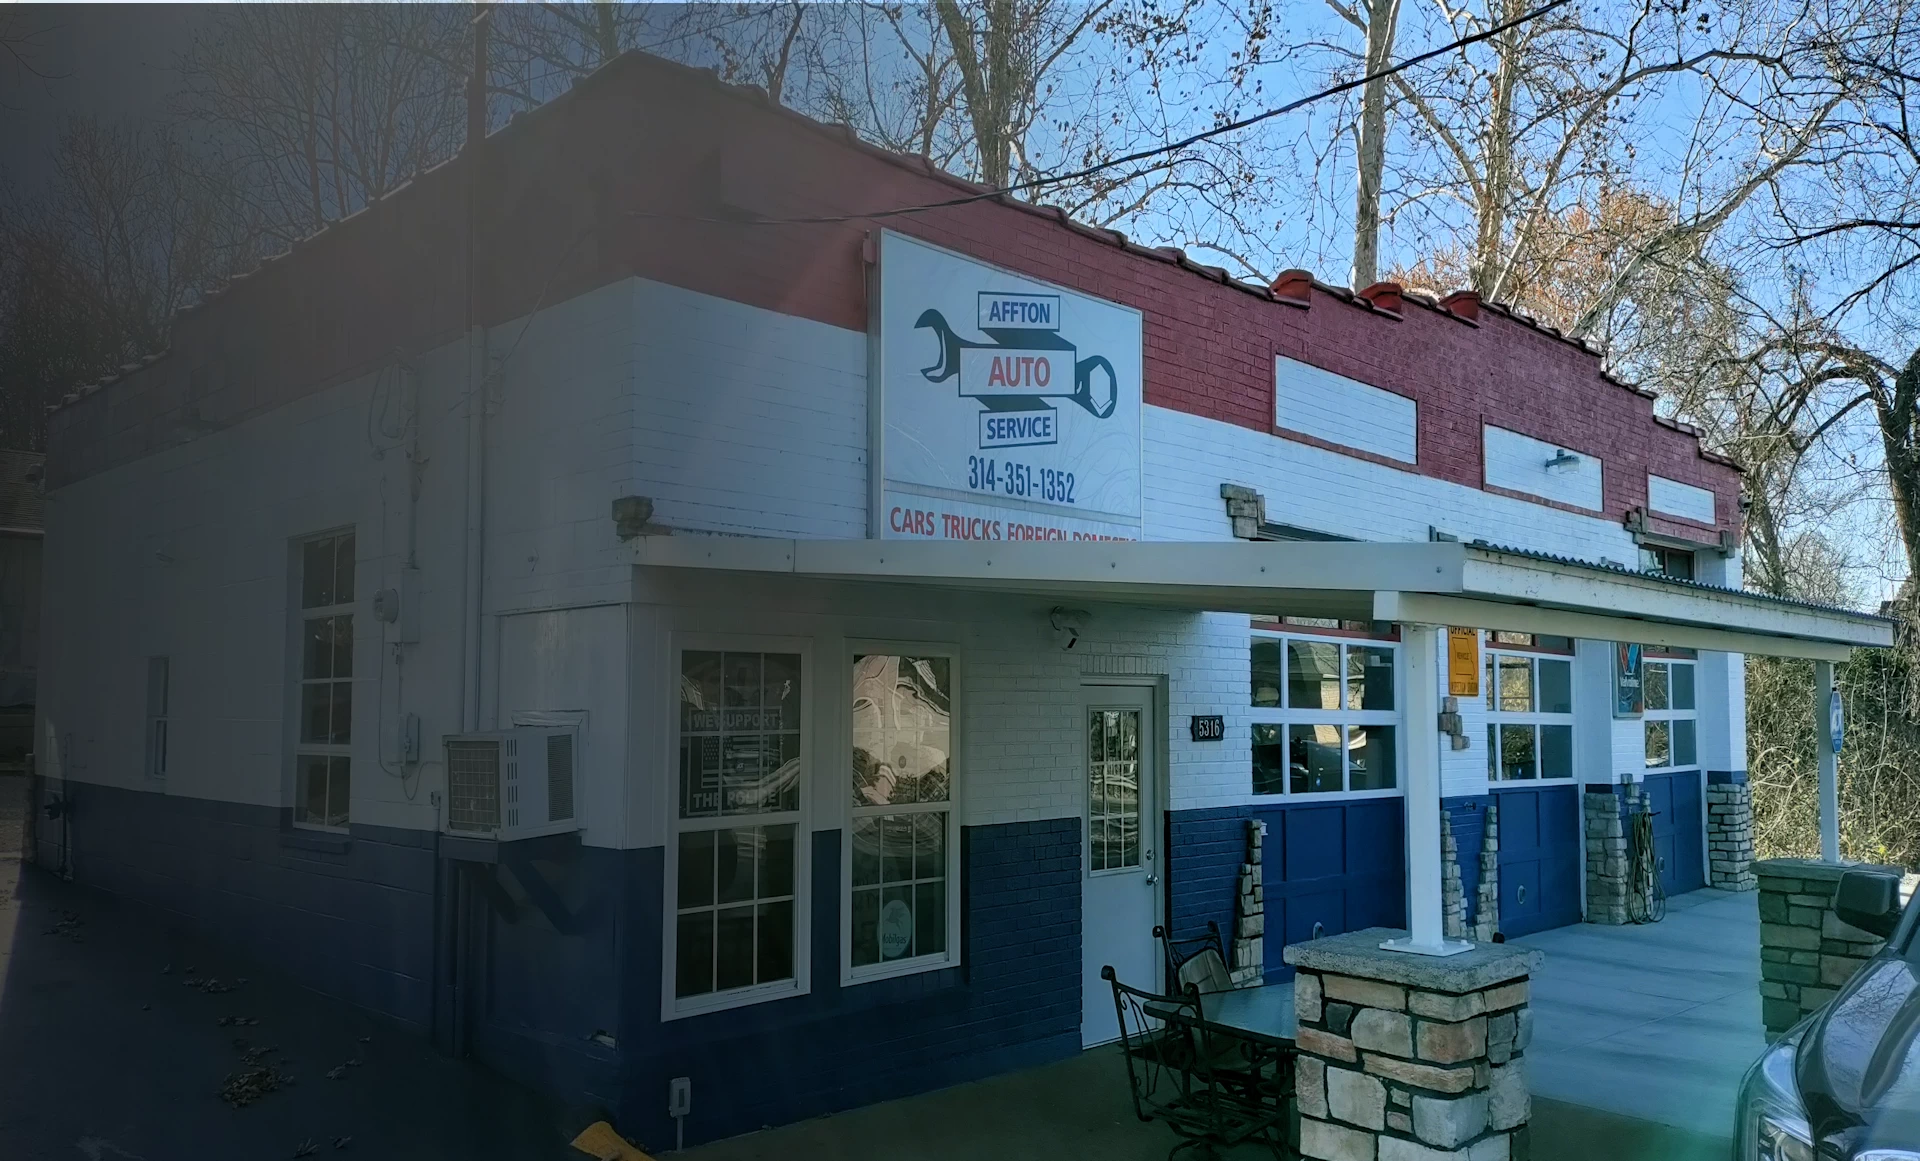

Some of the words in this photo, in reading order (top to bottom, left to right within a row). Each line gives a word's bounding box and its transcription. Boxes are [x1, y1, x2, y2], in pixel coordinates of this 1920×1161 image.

[989, 301, 1050, 323] AFFTON
[988, 356, 1051, 387] AUTO
[987, 416, 1051, 440] SERVICE
[968, 455, 1075, 504] 314-351-1352
[890, 507, 935, 536] CARS
[942, 513, 1001, 541] TRUCKS
[693, 714, 714, 728] WE
[1199, 719, 1220, 737] 5316
[693, 792, 720, 809] THE
